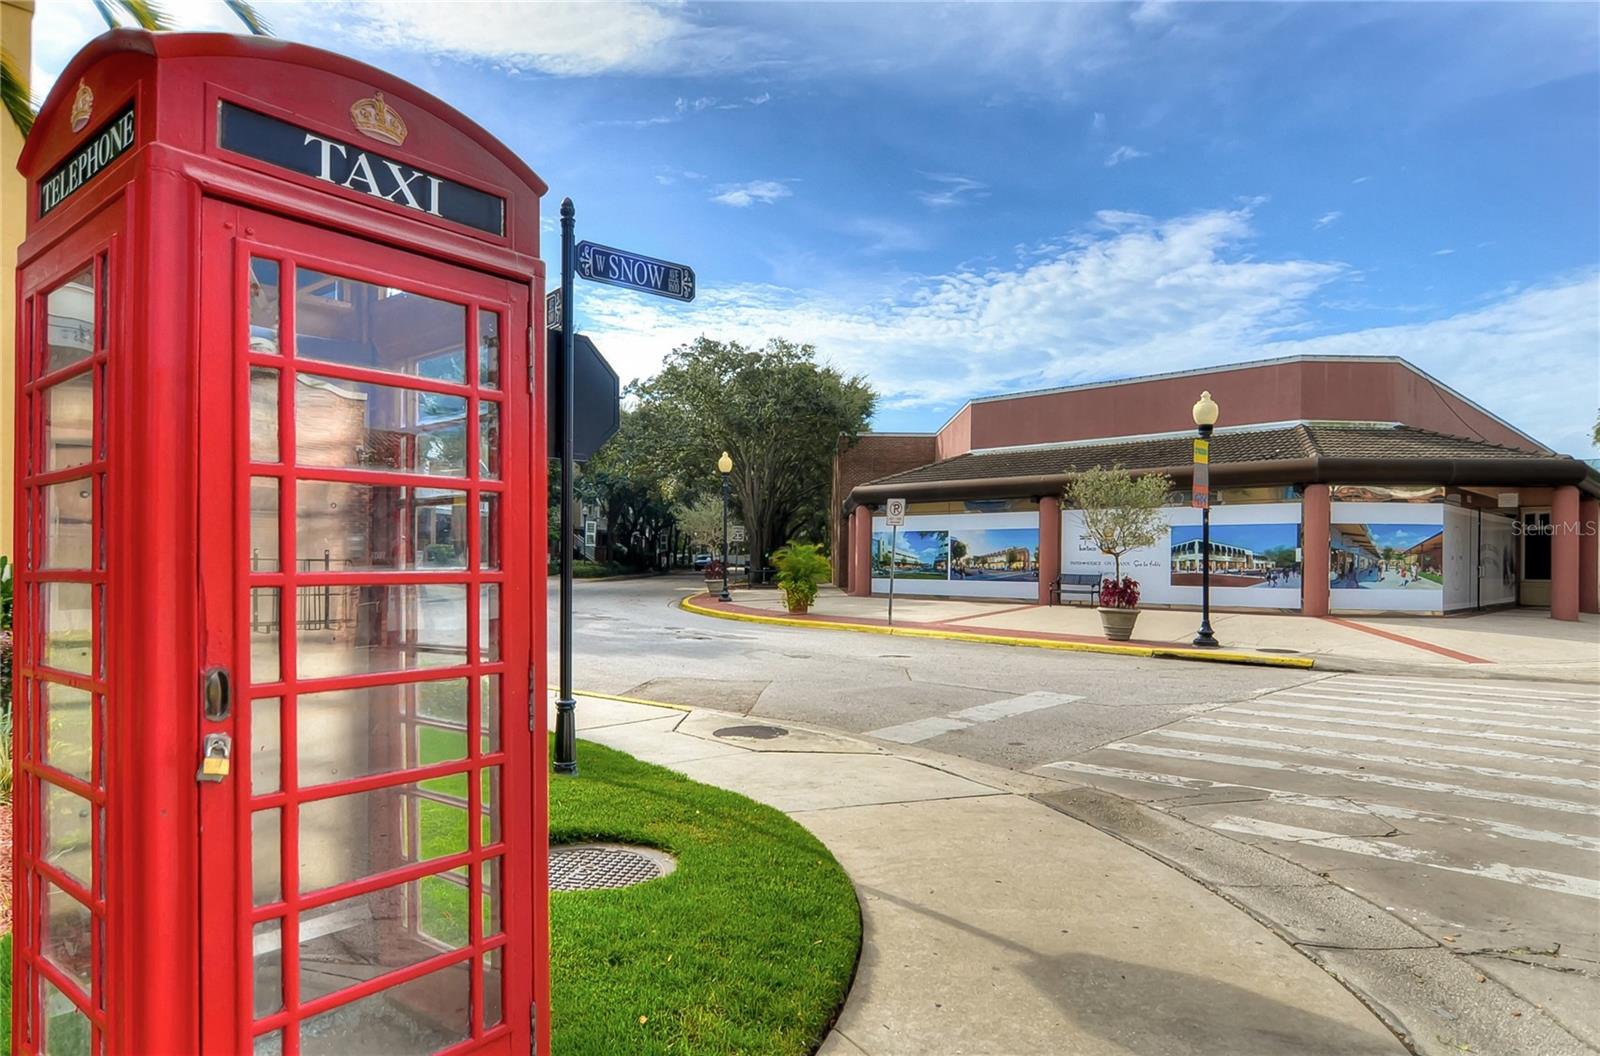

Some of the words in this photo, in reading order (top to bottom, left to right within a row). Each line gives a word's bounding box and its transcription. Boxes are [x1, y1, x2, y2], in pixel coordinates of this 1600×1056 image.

[42, 110, 134, 212] TELEPHONE
[303, 133, 444, 218] TAXI
[596, 254, 606, 273] W
[608, 254, 665, 289] SNOW
